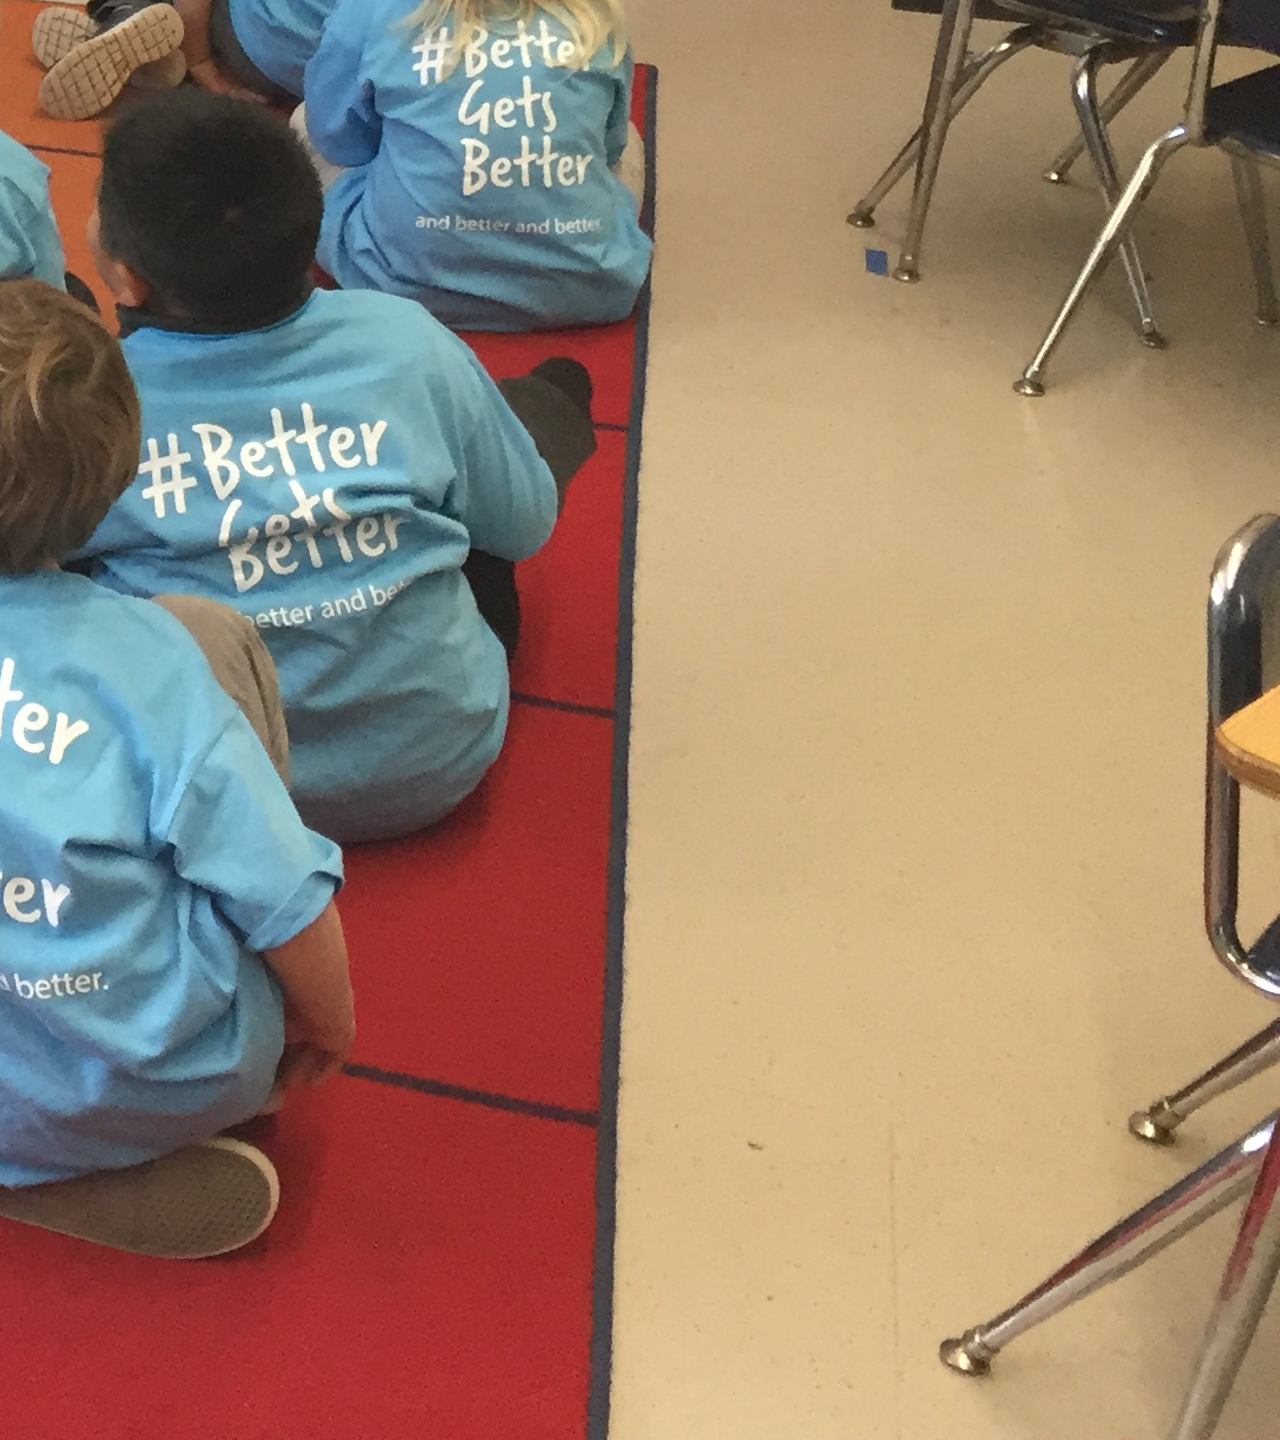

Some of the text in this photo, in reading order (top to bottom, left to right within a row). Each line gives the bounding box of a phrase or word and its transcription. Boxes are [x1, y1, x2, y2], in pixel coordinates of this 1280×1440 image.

[411, 19, 589, 86] #Bette
[457, 75, 557, 135] Gets
[460, 135, 594, 196] Better
[415, 215, 450, 231] and
[455, 215, 510, 233] better
[515, 218, 550, 234] and
[138, 402, 388, 519] #Better
[321, 587, 368, 619] and
[13, 971, 110, 1000] better.
